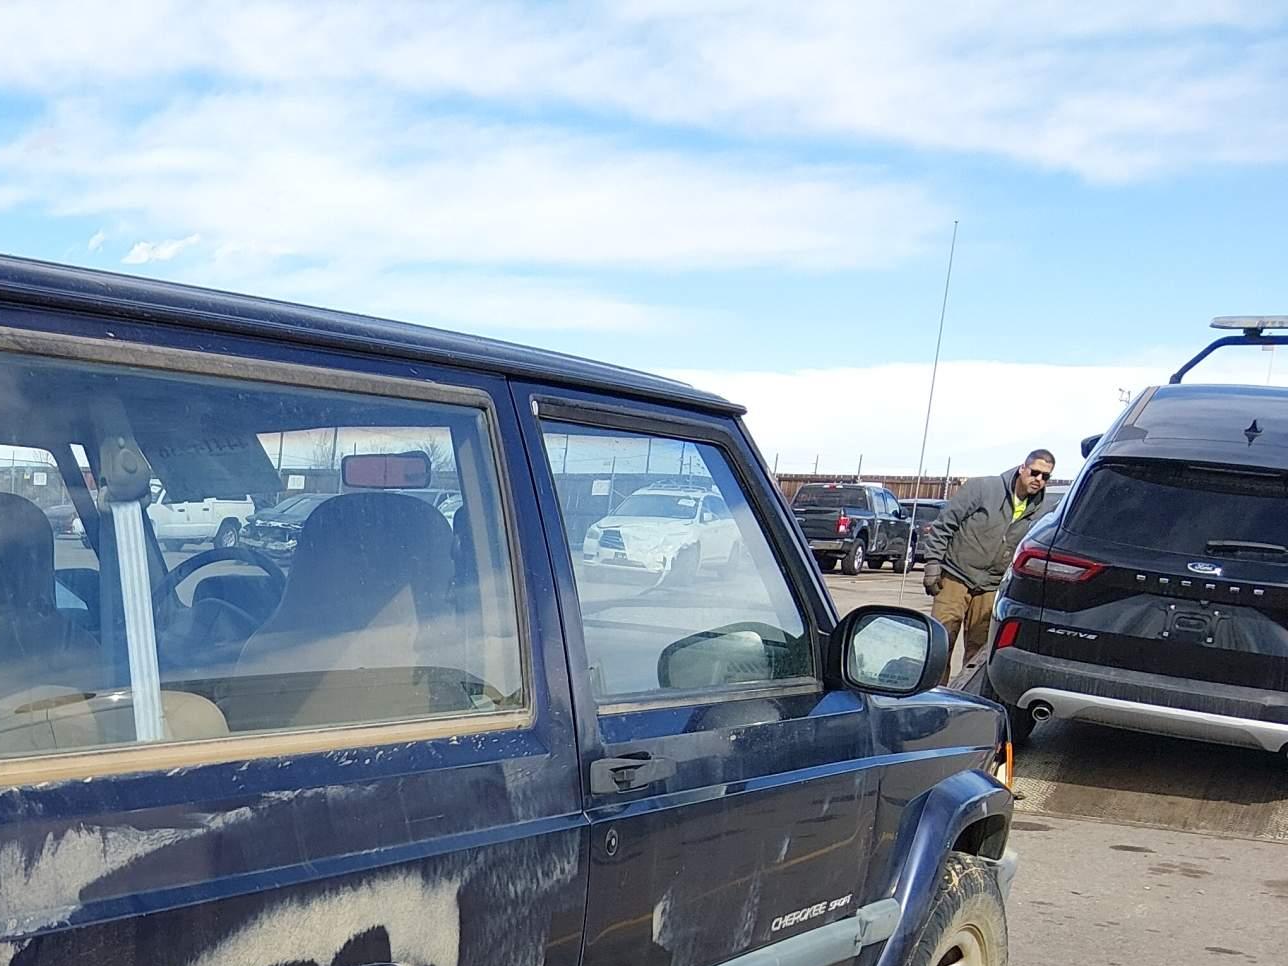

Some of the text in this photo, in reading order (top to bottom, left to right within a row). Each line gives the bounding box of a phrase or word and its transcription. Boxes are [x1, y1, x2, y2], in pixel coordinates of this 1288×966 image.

[1047, 628, 1099, 641] ACTIVE
[771, 893, 854, 932] CHEROKEE SPORT
